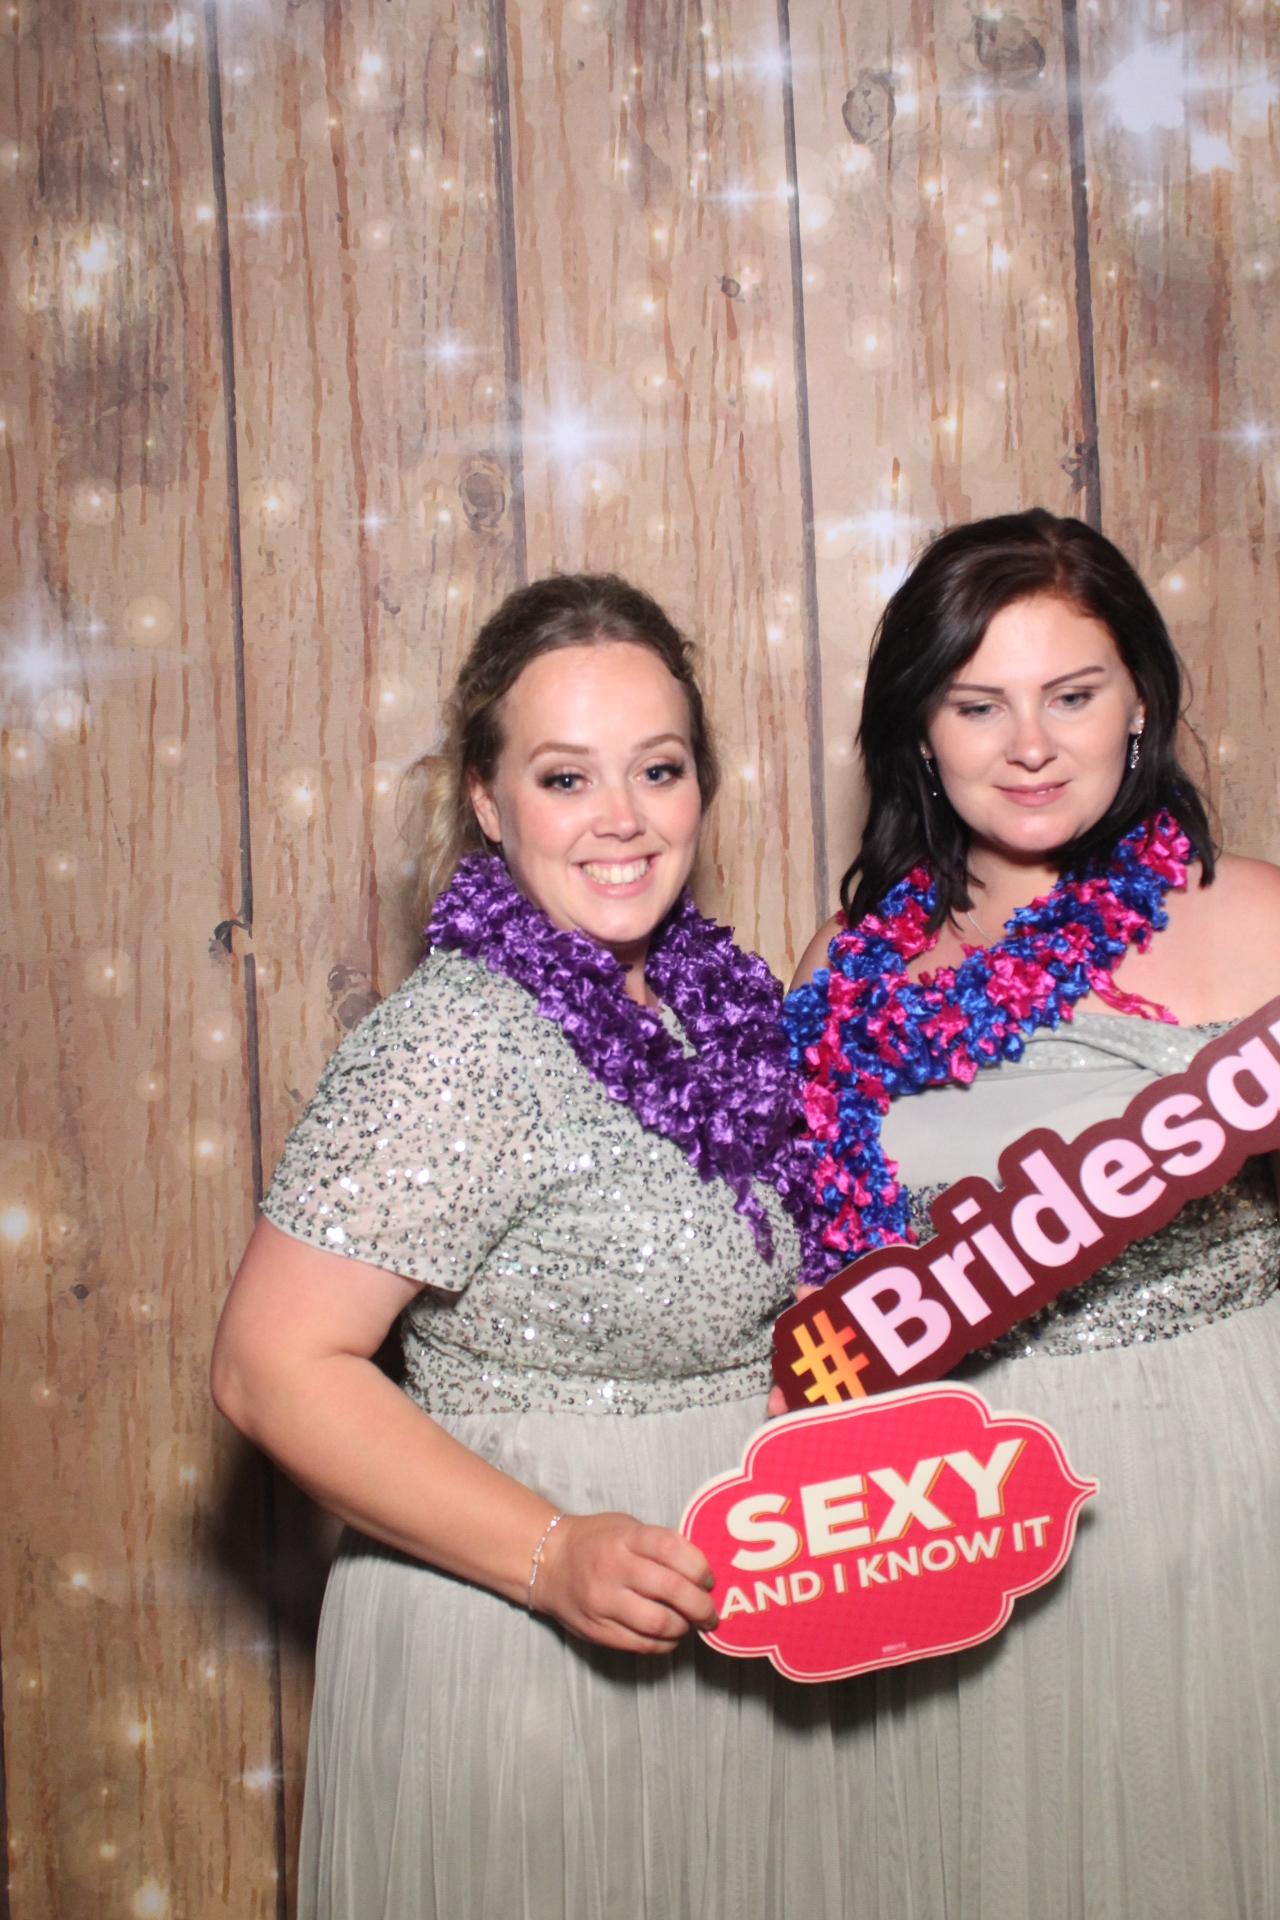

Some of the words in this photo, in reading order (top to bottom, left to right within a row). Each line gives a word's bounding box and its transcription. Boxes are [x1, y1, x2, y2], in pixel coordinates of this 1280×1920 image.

[790, 1018, 1280, 1406] #Bridesq
[719, 1570, 824, 1620] AND
[834, 1562, 848, 1594] I
[857, 1527, 1002, 1589] KNOW
[1013, 1516, 1053, 1553] IT
[725, 1438, 1026, 1571] SEXY
